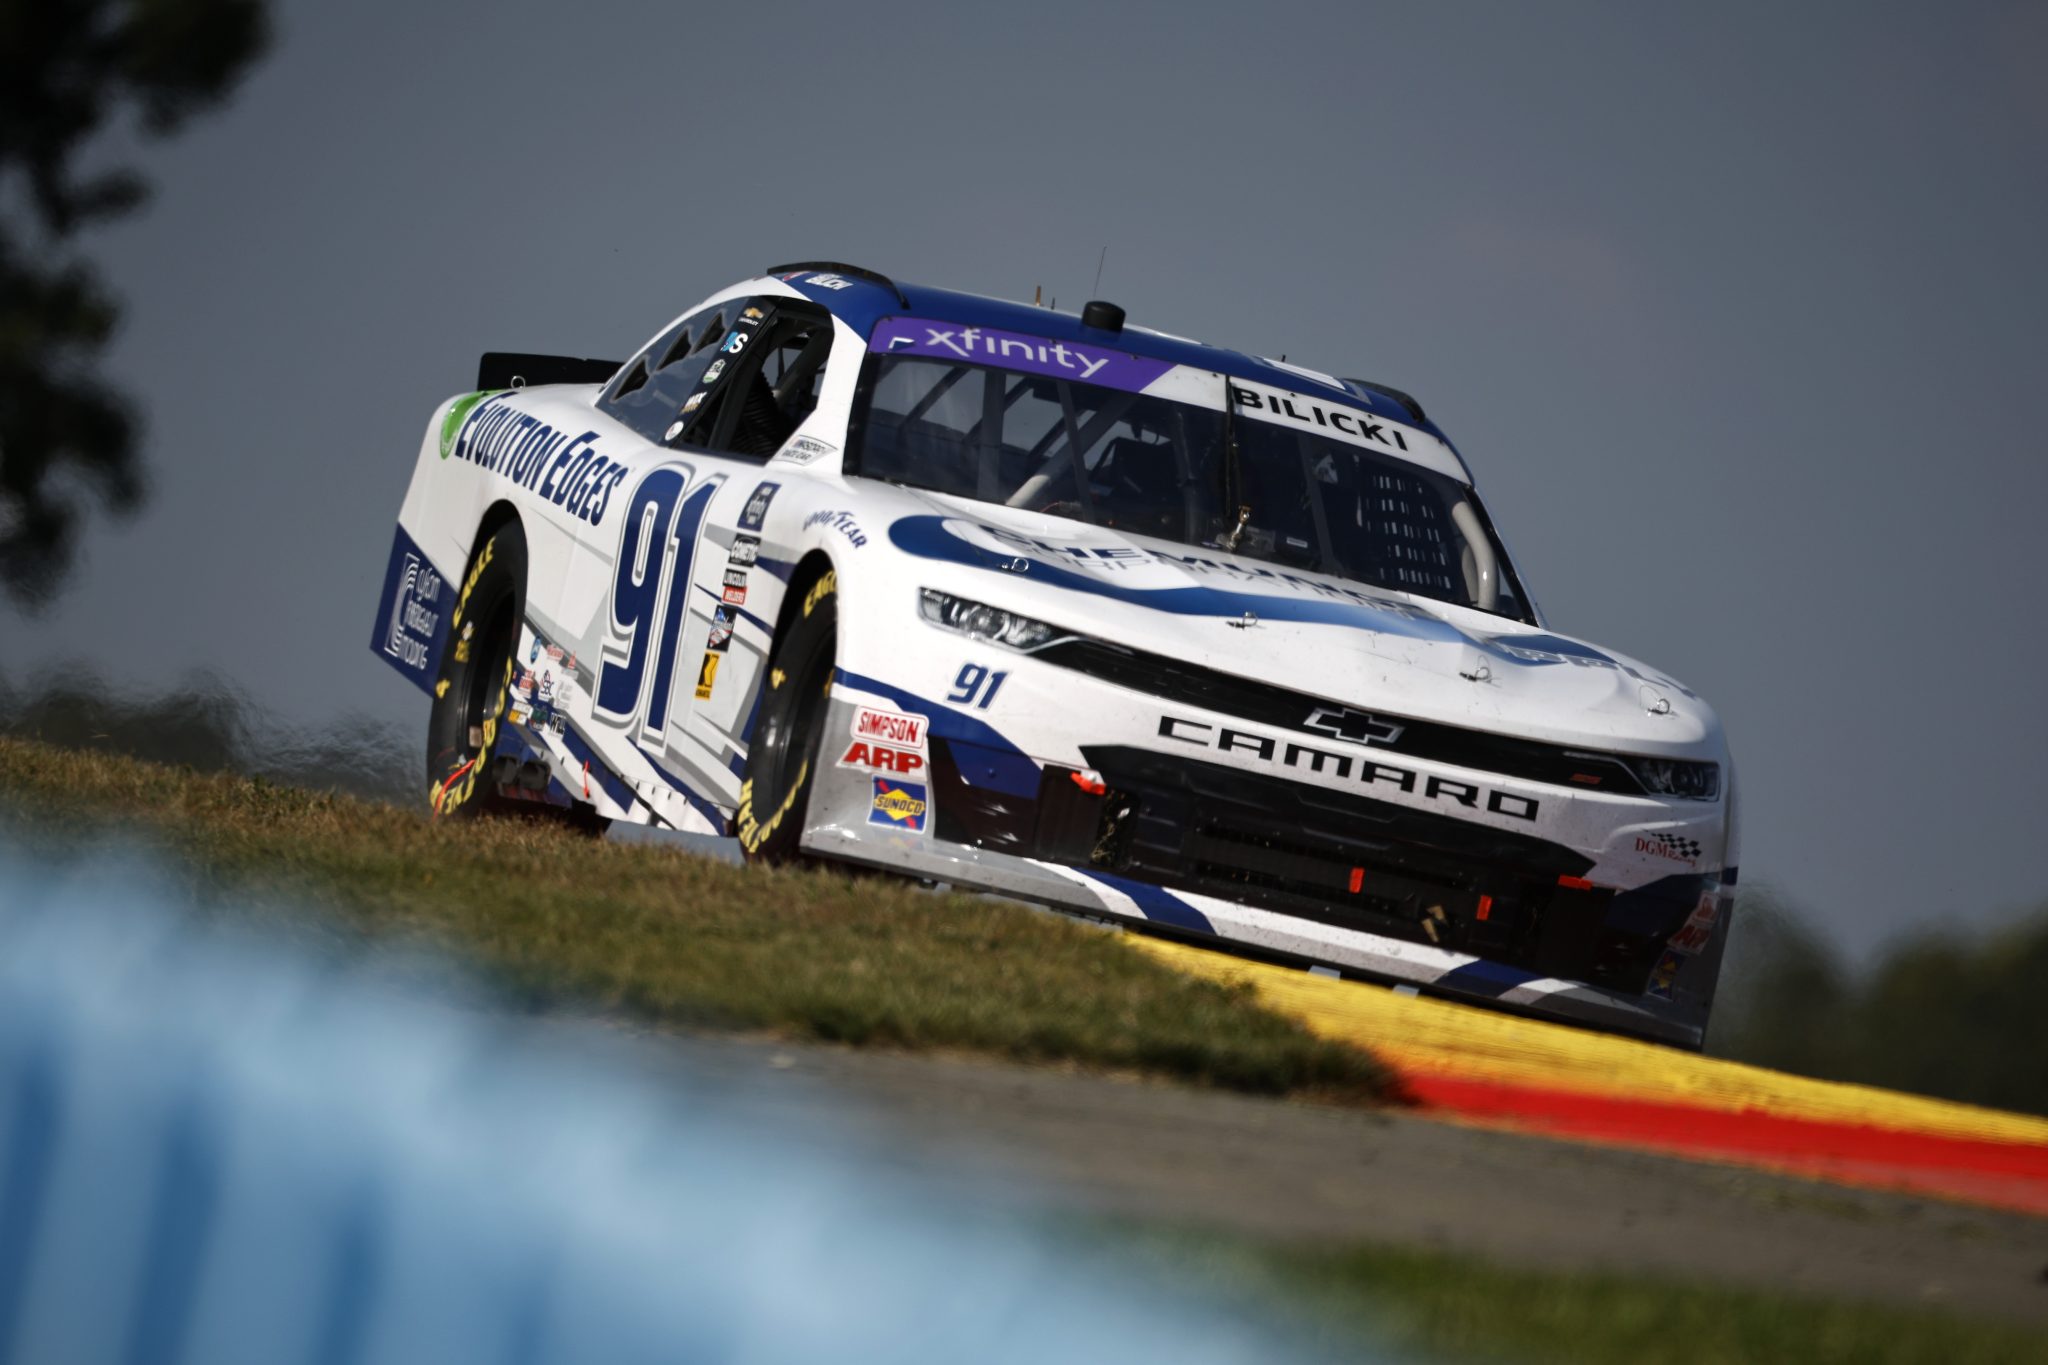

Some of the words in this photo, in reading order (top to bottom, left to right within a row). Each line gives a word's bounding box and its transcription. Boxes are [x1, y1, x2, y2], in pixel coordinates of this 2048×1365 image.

[926, 328, 1110, 379] xfinity
[1233, 385, 1410, 452] BILICKI
[455, 391, 568, 491] EVOLUTION
[539, 431, 628, 526] EDGES
[595, 463, 724, 750] 91
[803, 570, 837, 618] EAGL
[946, 662, 1009, 712] 91
[858, 711, 920, 743] SIMPSON
[843, 742, 923, 773] ARP
[1158, 715, 1540, 822] CAMARO
[876, 796, 924, 816] SUNOCO
[1635, 837, 1669, 858] DGM
